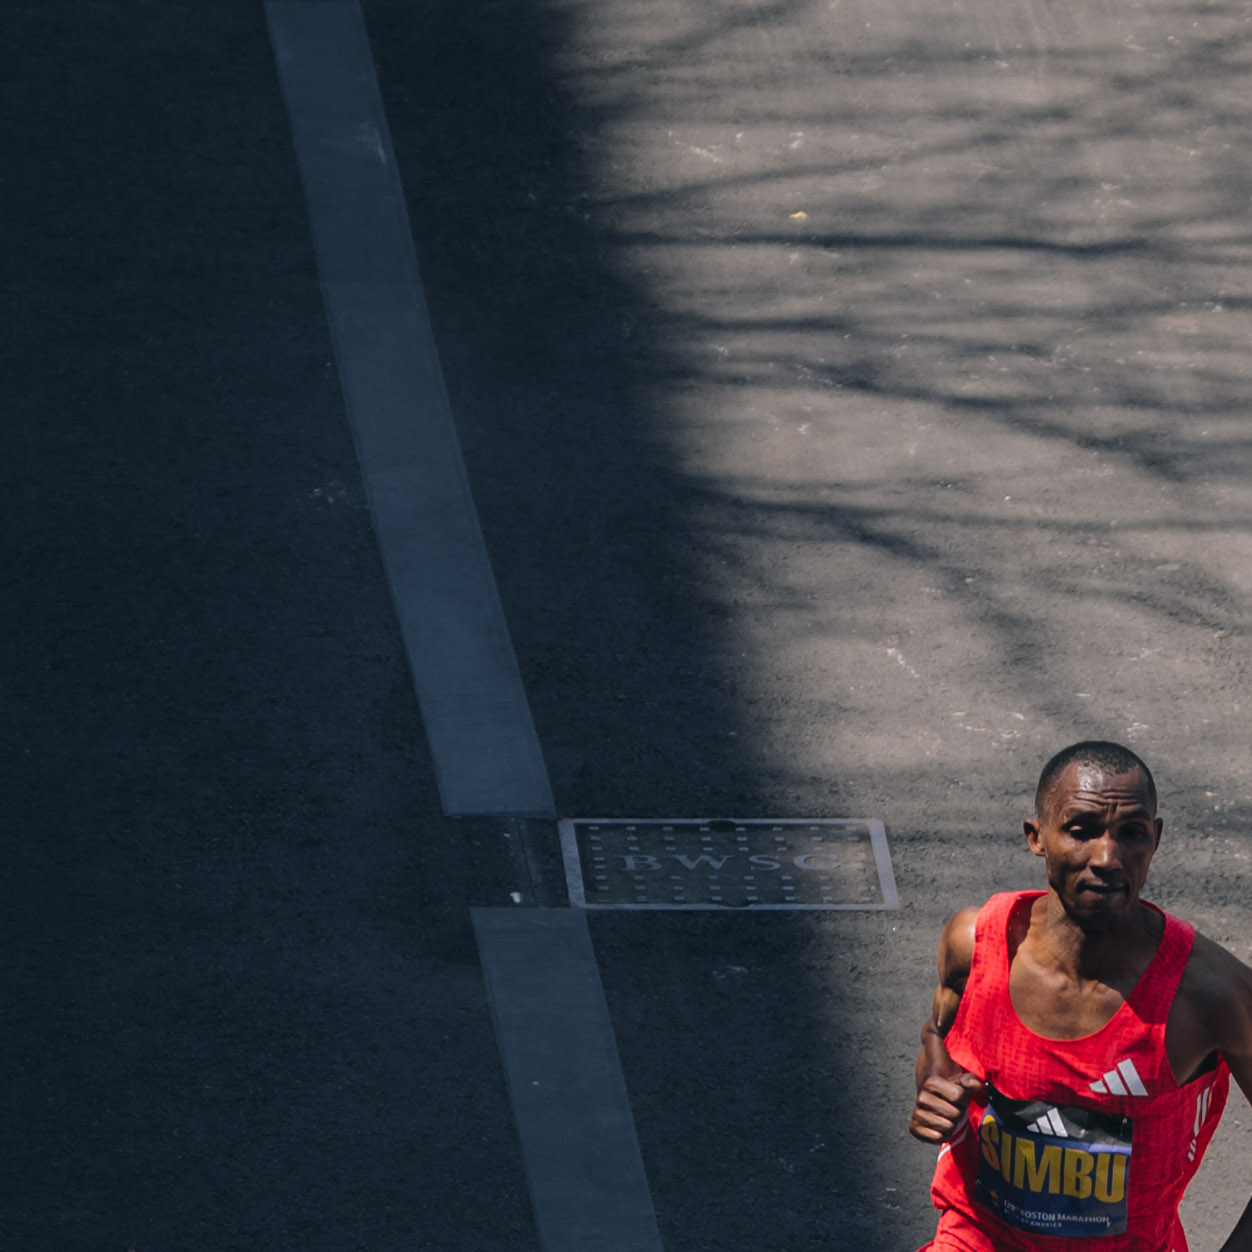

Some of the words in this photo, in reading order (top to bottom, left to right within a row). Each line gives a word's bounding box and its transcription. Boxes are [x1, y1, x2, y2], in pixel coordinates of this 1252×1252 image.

[621, 854, 840, 871] BWSC
[981, 1114, 1127, 1204] SIMBU
[1057, 1212, 1110, 1224] MARATHON
